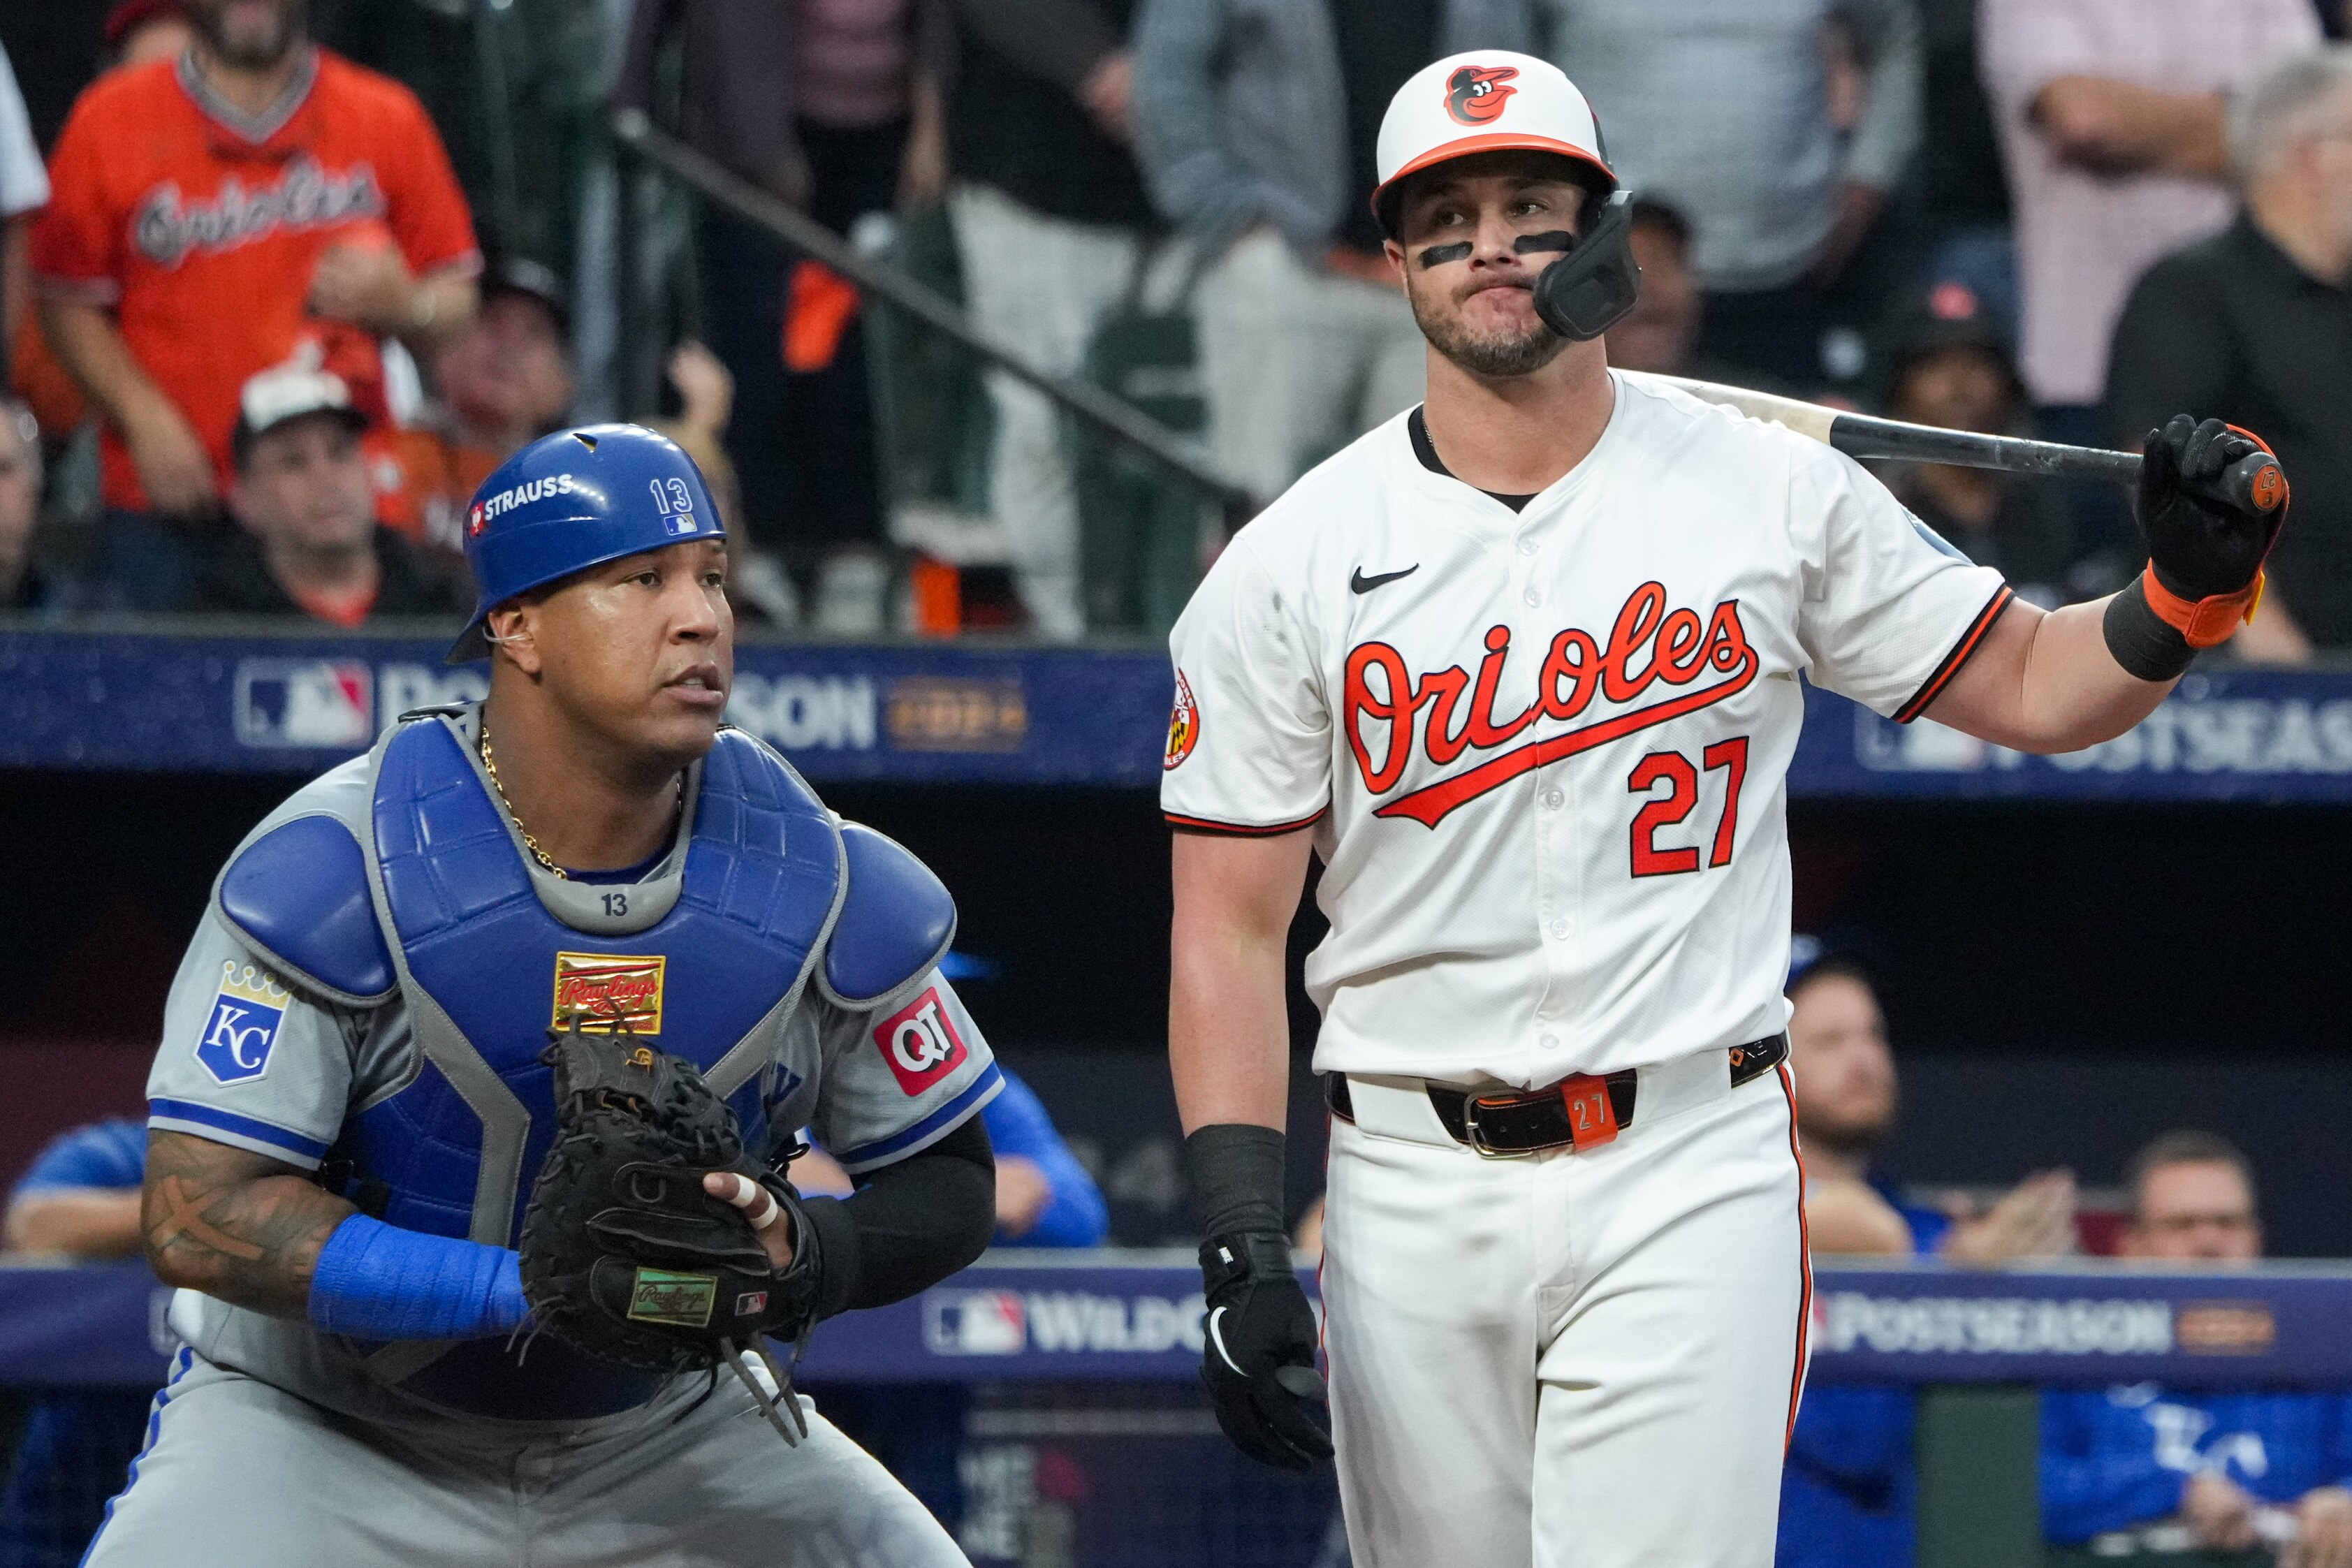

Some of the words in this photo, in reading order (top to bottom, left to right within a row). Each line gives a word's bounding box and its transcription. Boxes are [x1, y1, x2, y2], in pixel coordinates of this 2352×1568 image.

[485, 474, 574, 521] STRAUSS
[650, 477, 693, 515] 13
[1344, 581, 1759, 803] Orioles
[1628, 735, 1749, 879] 27
[601, 893, 628, 916] 13
[560, 974, 658, 1009] Rawlings
[205, 1004, 271, 1069] KC
[892, 1000, 951, 1072] QT
[1573, 1092, 1605, 1130] 27
